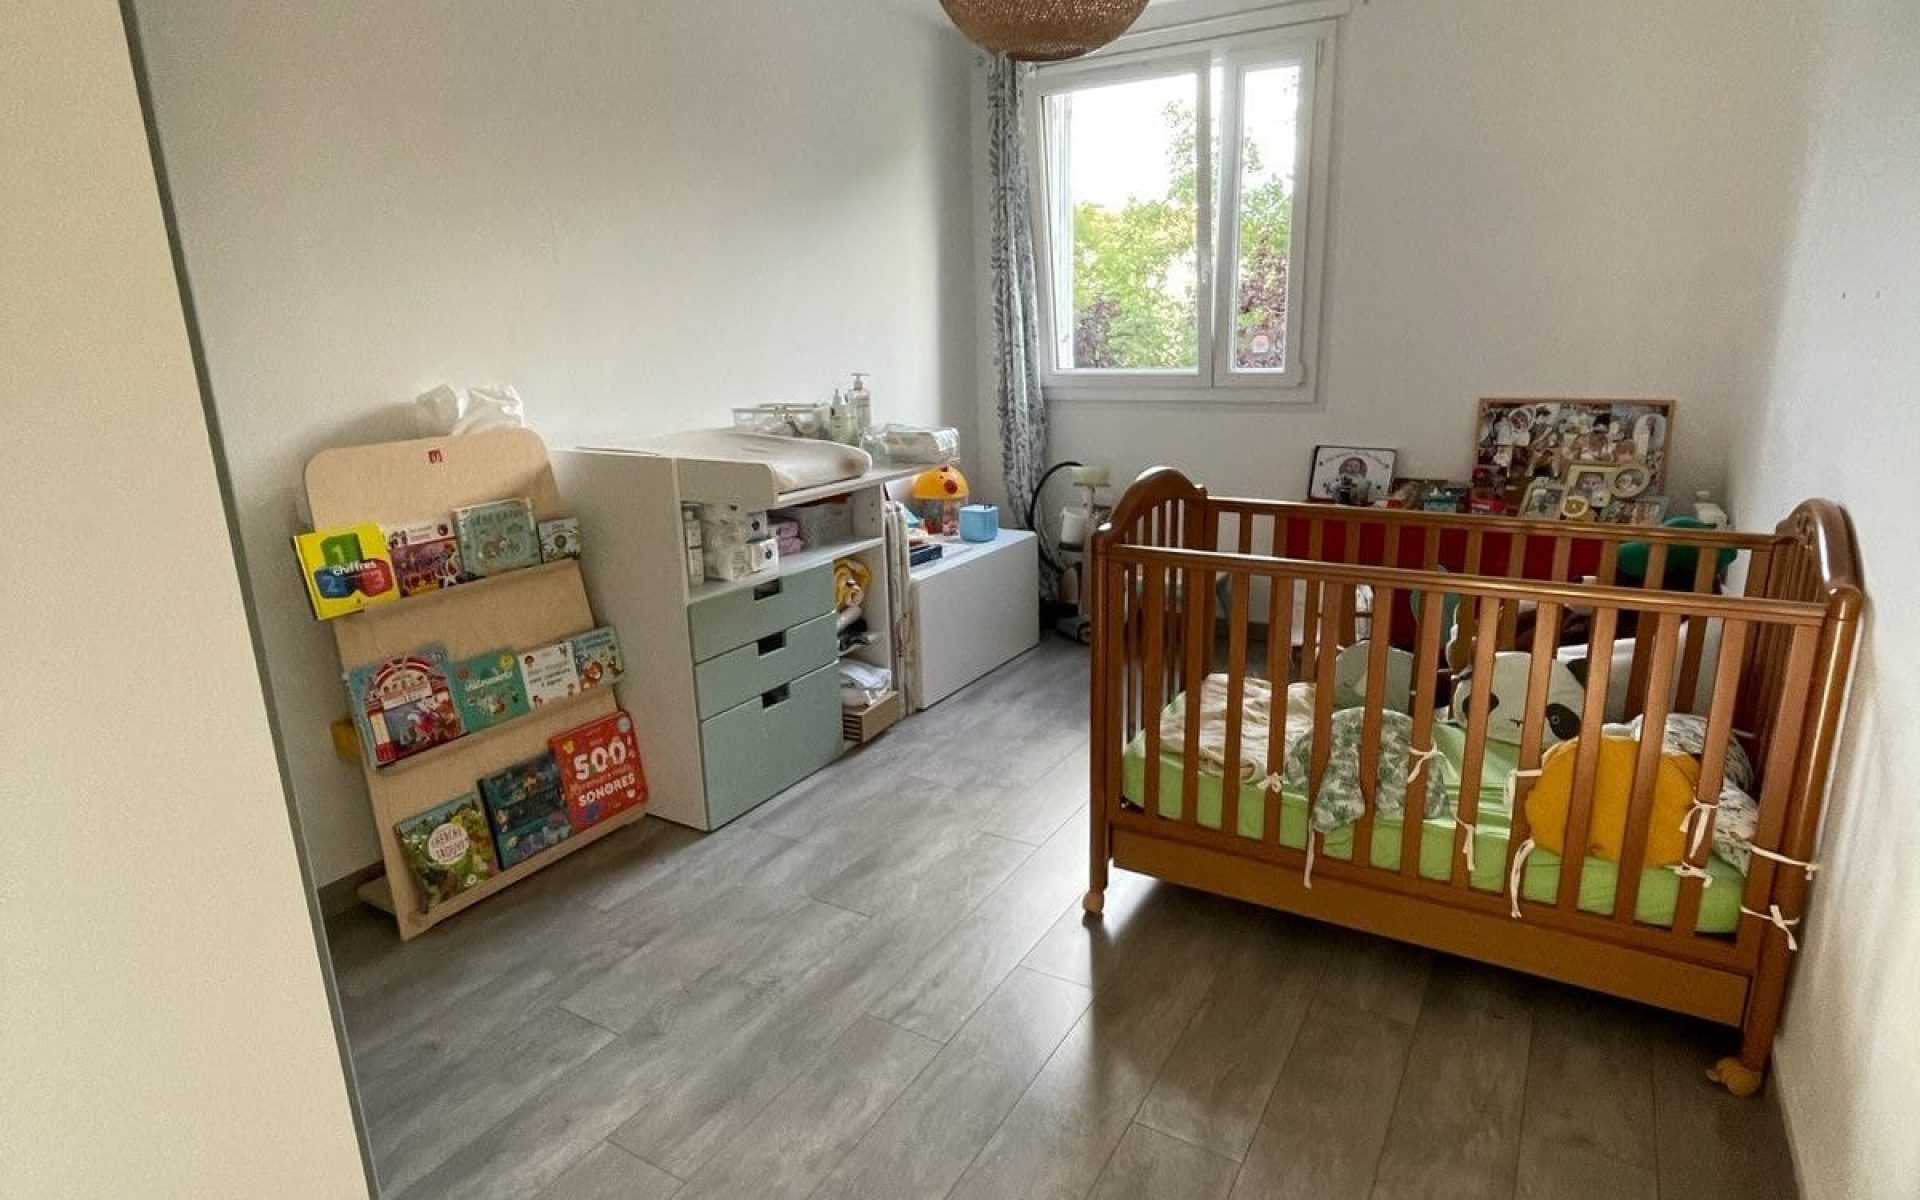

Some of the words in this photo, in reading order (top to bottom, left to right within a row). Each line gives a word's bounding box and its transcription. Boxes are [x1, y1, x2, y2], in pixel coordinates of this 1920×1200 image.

[332, 545, 345, 564] 1
[319, 576, 341, 593] 2
[362, 569, 385, 591] 3
[573, 736, 627, 780] 500
[578, 772, 636, 807] SONORES
